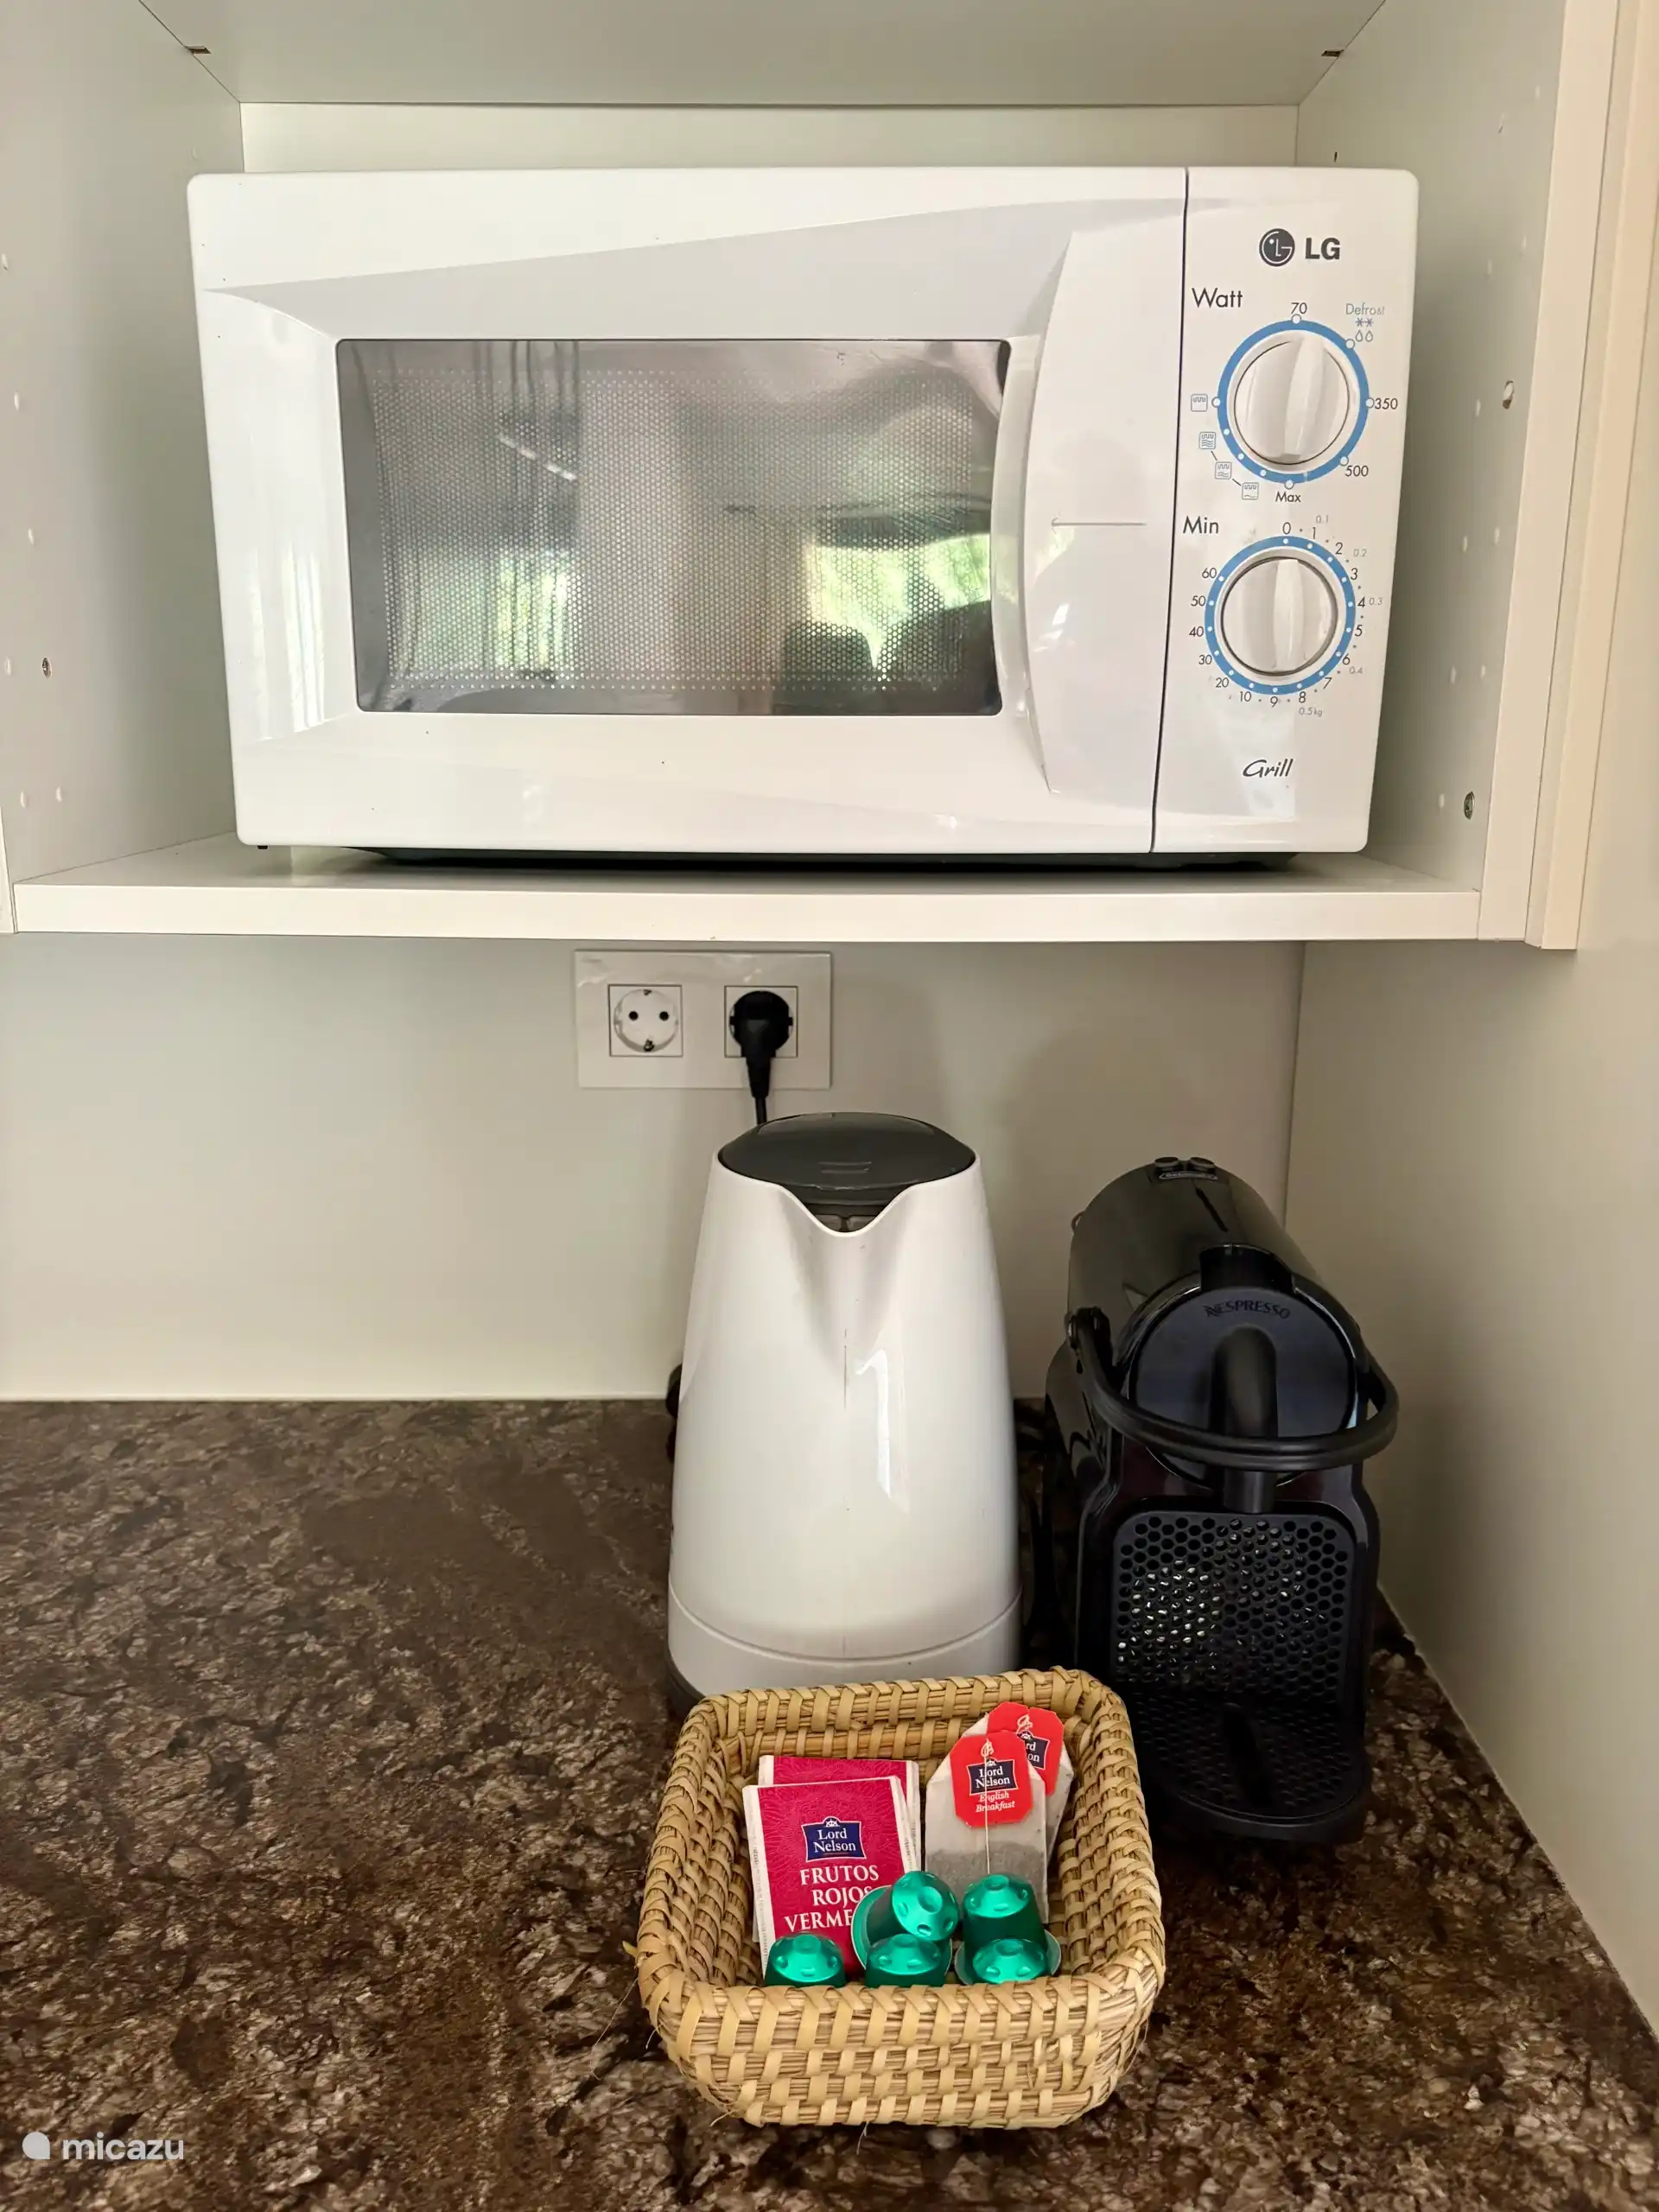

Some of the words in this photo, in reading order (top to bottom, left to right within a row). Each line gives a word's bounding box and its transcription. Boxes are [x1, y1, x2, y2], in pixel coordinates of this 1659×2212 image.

[1305, 237, 1340, 260] LG
[1191, 287, 1243, 308] Watt
[1290, 302, 1307, 315] 70
[1345, 302, 1386, 316] Defrost
[1374, 397, 1399, 410] 350
[1344, 465, 1370, 478] 500
[1275, 491, 1301, 503] Max
[1183, 515, 1219, 535] Min
[1282, 522, 1292, 535] 0
[1311, 526, 1318, 540] 1
[1335, 542, 1344, 556] 2
[1353, 548, 1368, 558] 0.2
[1201, 567, 1217, 580] 60
[1350, 568, 1358, 581] 3
[1190, 594, 1206, 607] 50
[1357, 596, 1366, 609] 4
[1368, 597, 1382, 607] 0.3
[1189, 626, 1205, 639] 40
[1354, 624, 1363, 638] 5
[1198, 654, 1212, 666] 30
[1342, 653, 1351, 666] 6
[1349, 666, 1363, 676] 0.4
[1215, 677, 1230, 690] 20
[1323, 677, 1333, 690] 7
[1239, 691, 1252, 703] 10
[1269, 696, 1279, 709] 9
[1298, 691, 1306, 704] 8
[1242, 758, 1294, 779] Grill
[1203, 1299, 1291, 1319] NESPRESSO
[979, 1765, 1004, 1778] Lord
[975, 1777, 1010, 1789] Nelson
[979, 1790, 1010, 1803] English
[976, 1800, 1016, 1813] Breakfast
[817, 1827, 848, 1840] Lord
[813, 1840, 856, 1853] Nelson
[799, 1865, 880, 1886] FRUTOS
[784, 1909, 853, 1933] VERME
